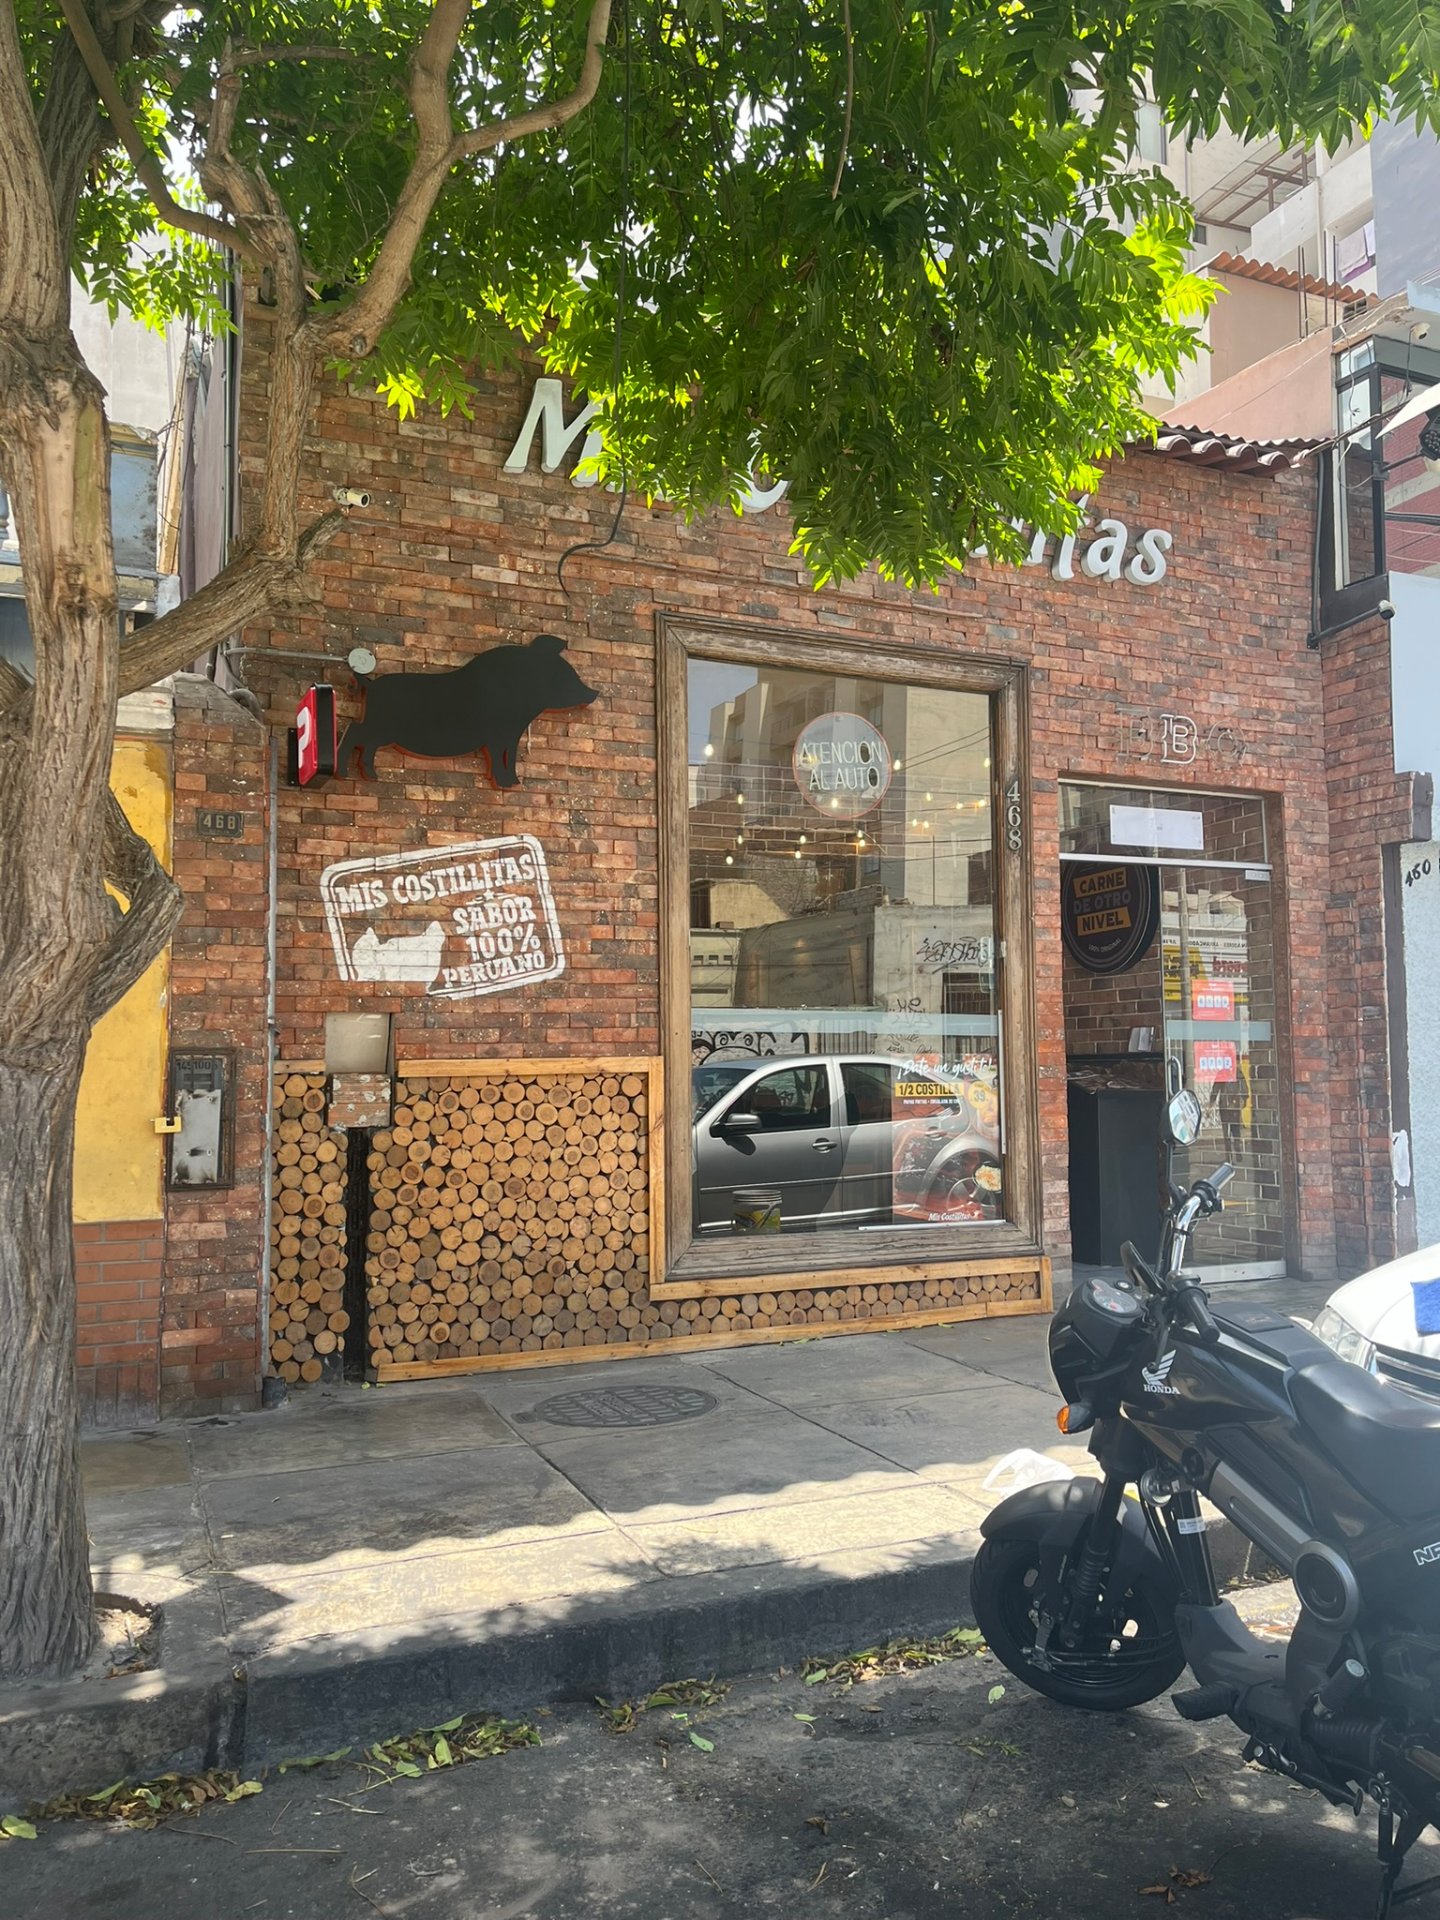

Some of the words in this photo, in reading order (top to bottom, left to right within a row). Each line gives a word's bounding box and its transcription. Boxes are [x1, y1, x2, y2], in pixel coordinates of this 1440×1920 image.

[809, 767, 830, 791] AL
[835, 765, 880, 791] AUTO
[203, 813, 236, 830] 468
[1006, 780, 1022, 851] 468
[334, 879, 389, 914] MIS
[391, 853, 536, 905] COSTILLITAS
[1079, 870, 1125, 894] CARNE
[1405, 858, 1431, 887] 460
[1073, 898, 1091, 914] DE
[1094, 889, 1132, 910] OTRO
[452, 895, 537, 935] SABOR
[1081, 911, 1124, 932] NIVEL
[465, 922, 541, 963] 100%
[441, 949, 546, 989] PERUANO
[933, 1061, 949, 1074] un
[899, 1083, 914, 1096] 1/2
[1143, 1383, 1182, 1395] HONDA
